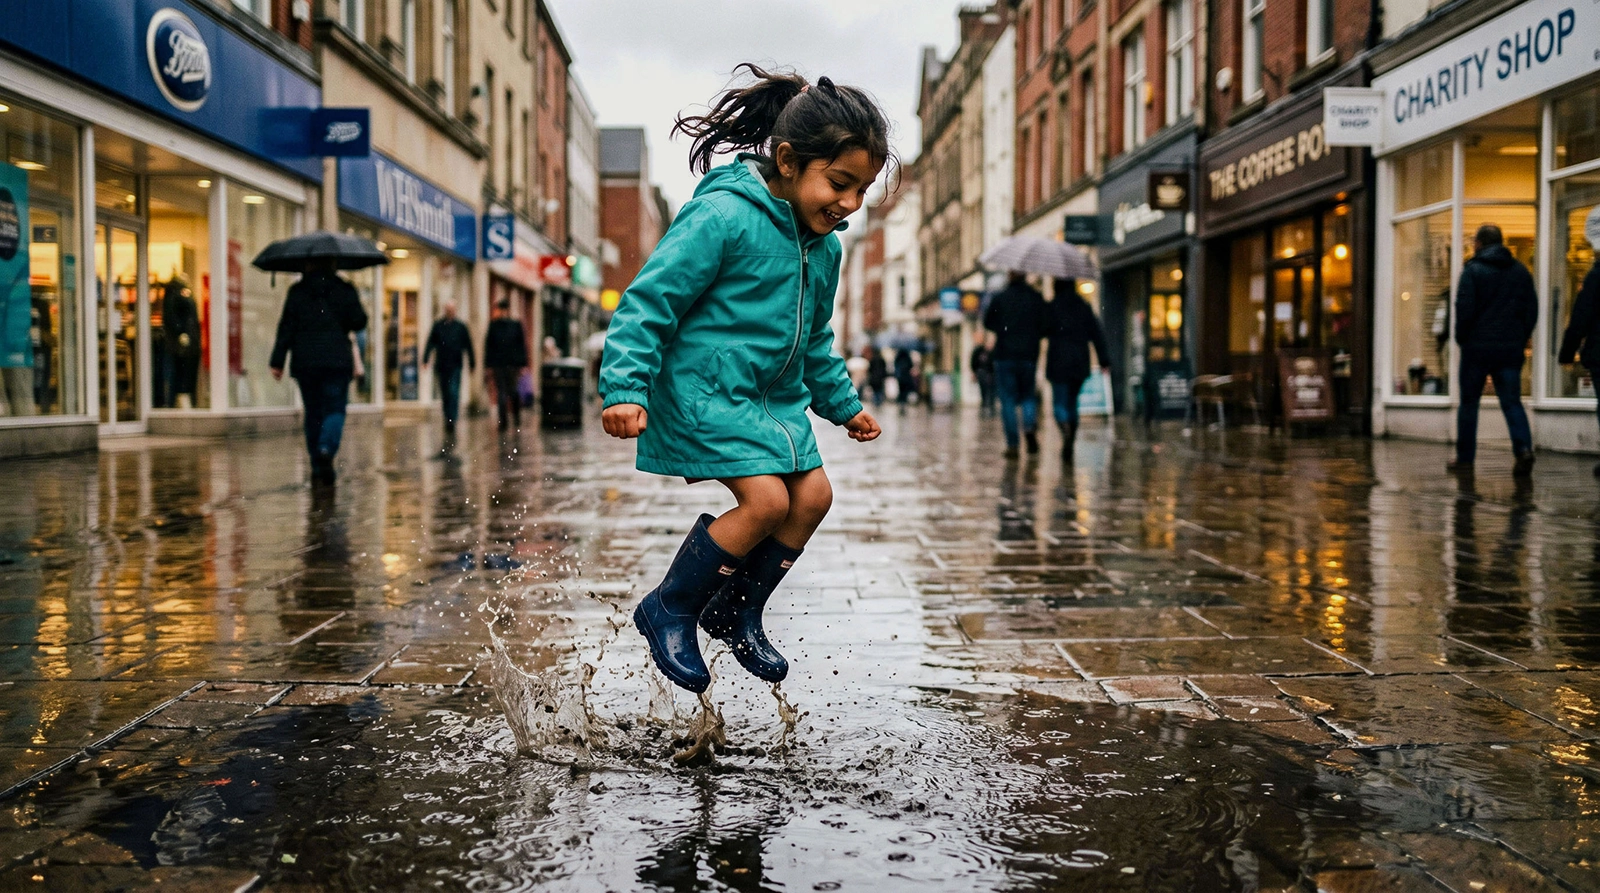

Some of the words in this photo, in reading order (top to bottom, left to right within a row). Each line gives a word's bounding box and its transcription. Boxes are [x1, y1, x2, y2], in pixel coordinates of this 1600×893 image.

[1394, 48, 1489, 124] CHARITY
[1497, 7, 1575, 80] SHOP
[375, 158, 457, 248] WHSmith
[1209, 162, 1237, 201] THE
[1237, 136, 1295, 191] COFFEE
[487, 222, 511, 258] S
